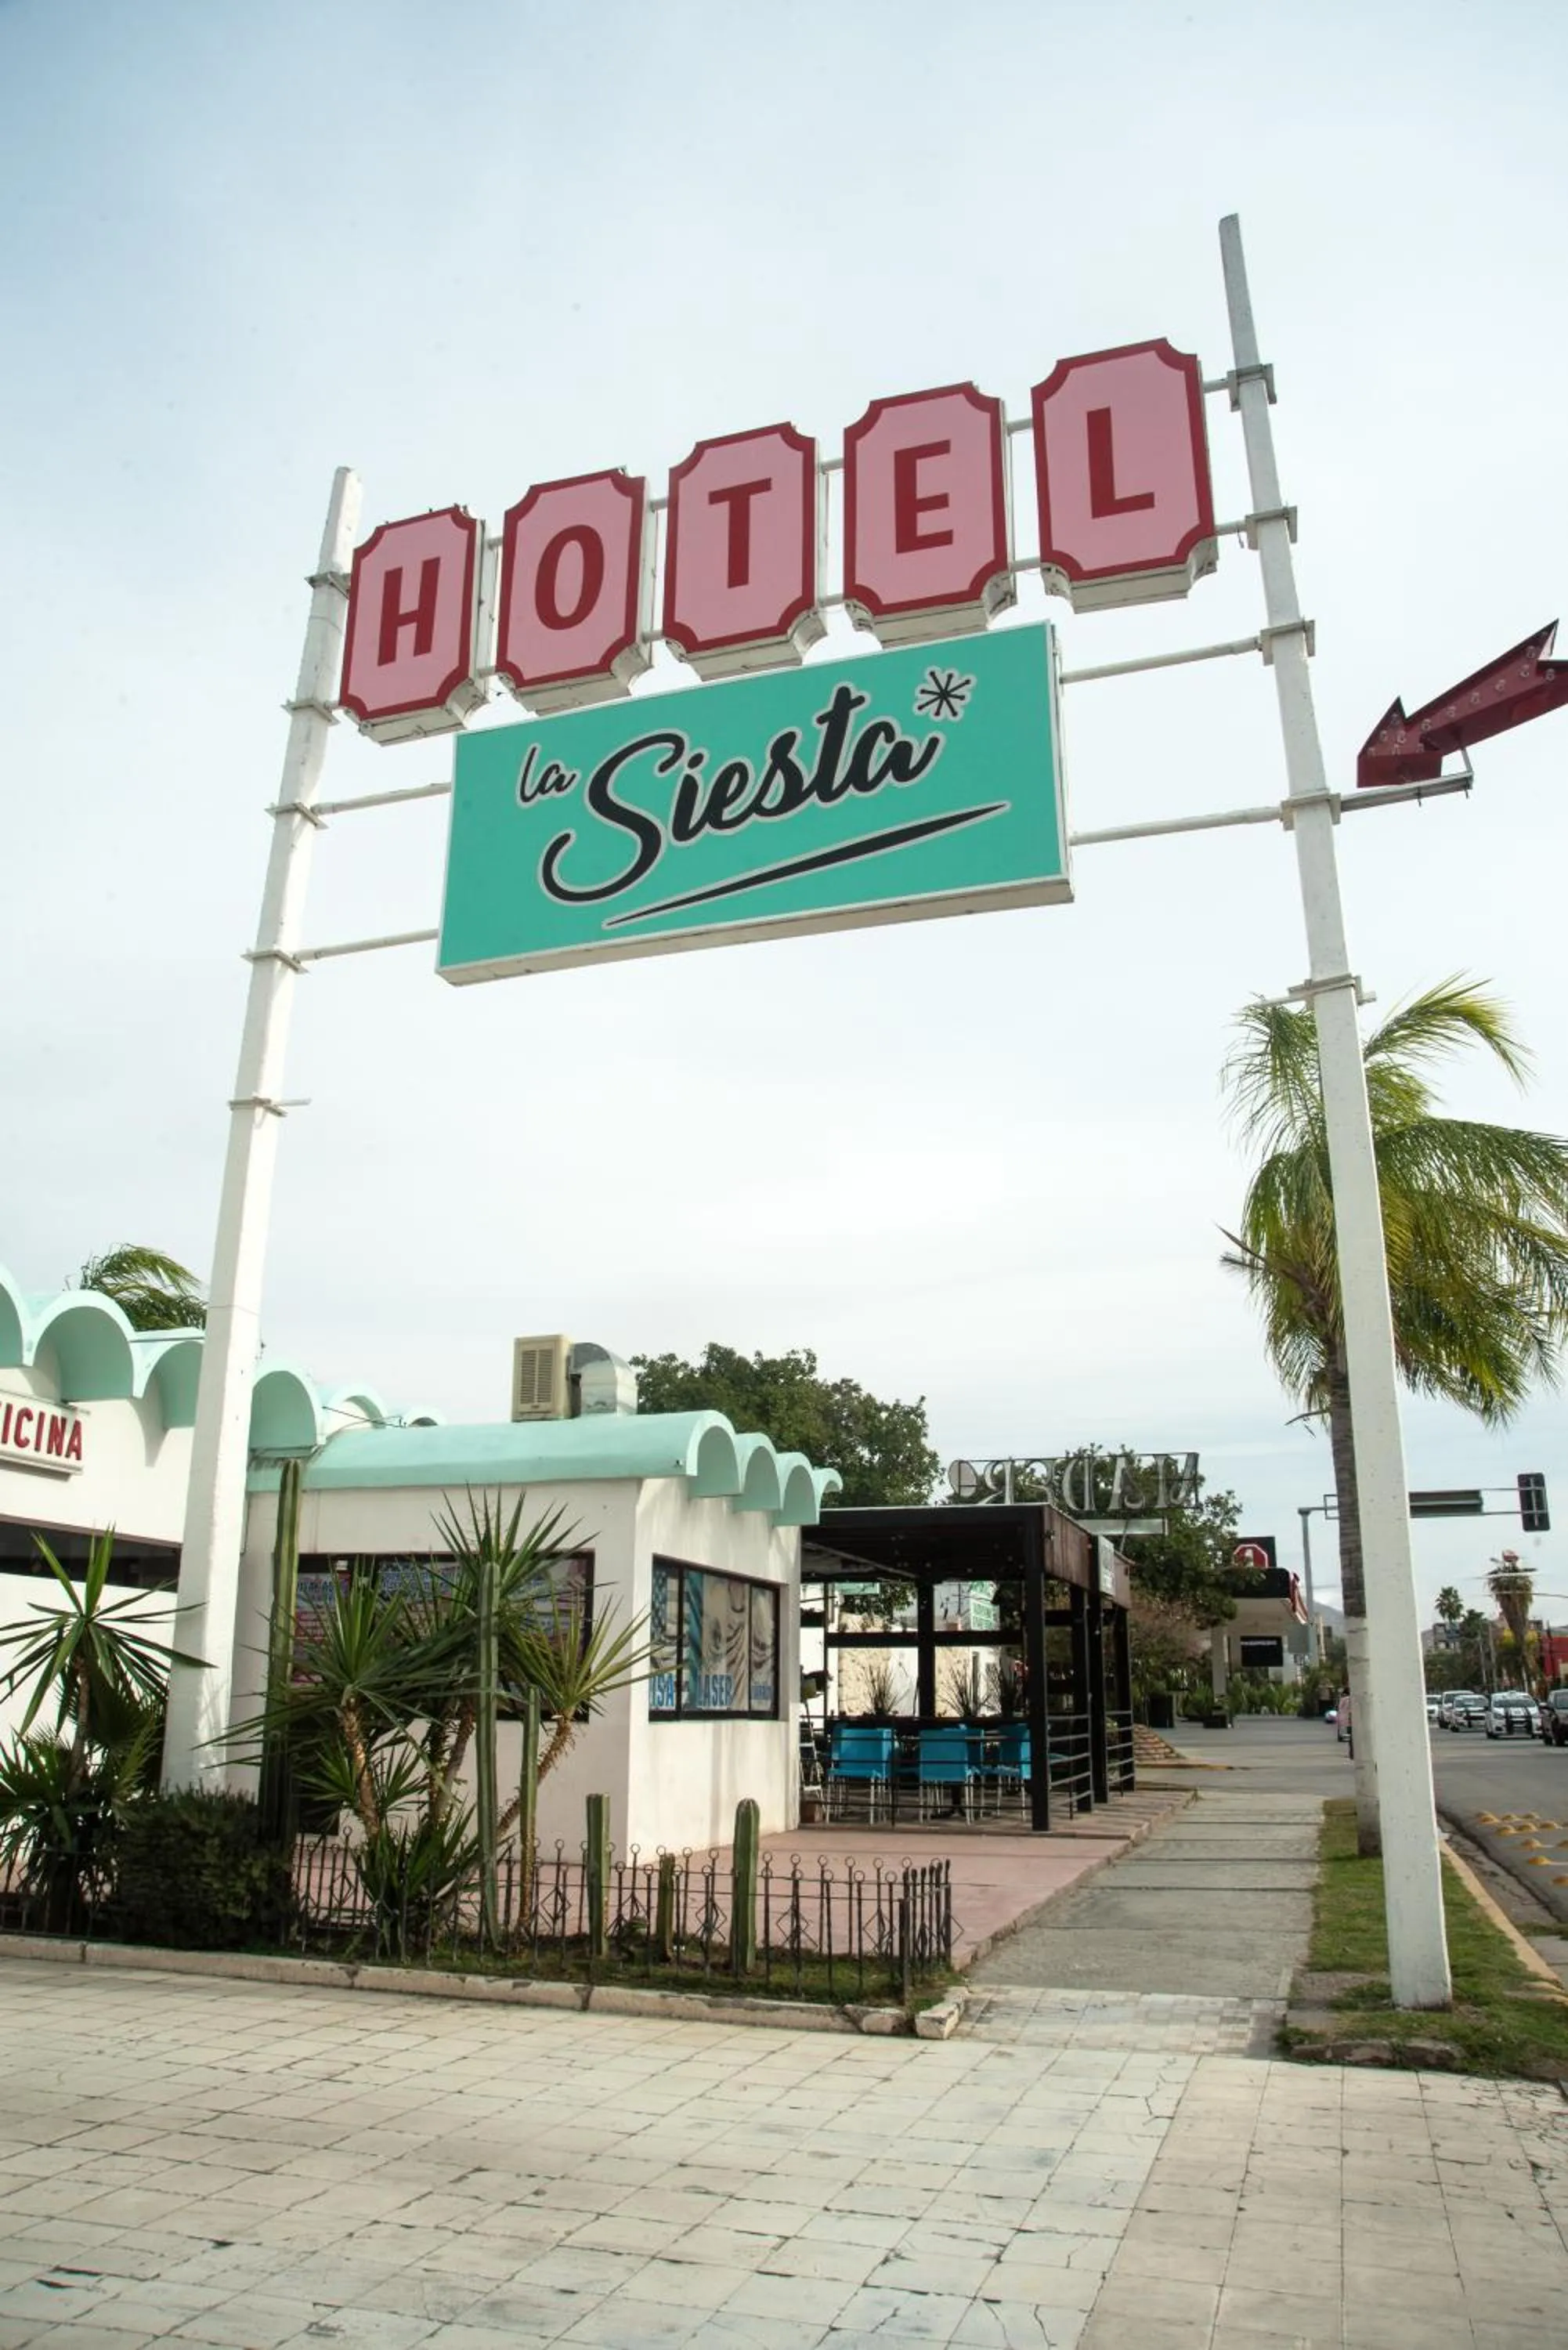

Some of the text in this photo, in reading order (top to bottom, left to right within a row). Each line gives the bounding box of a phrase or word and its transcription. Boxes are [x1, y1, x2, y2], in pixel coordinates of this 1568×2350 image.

[378, 407, 1155, 667] HOTEL
[519, 685, 940, 903] la Siesta
[0, 1401, 82, 1461] ICINA
